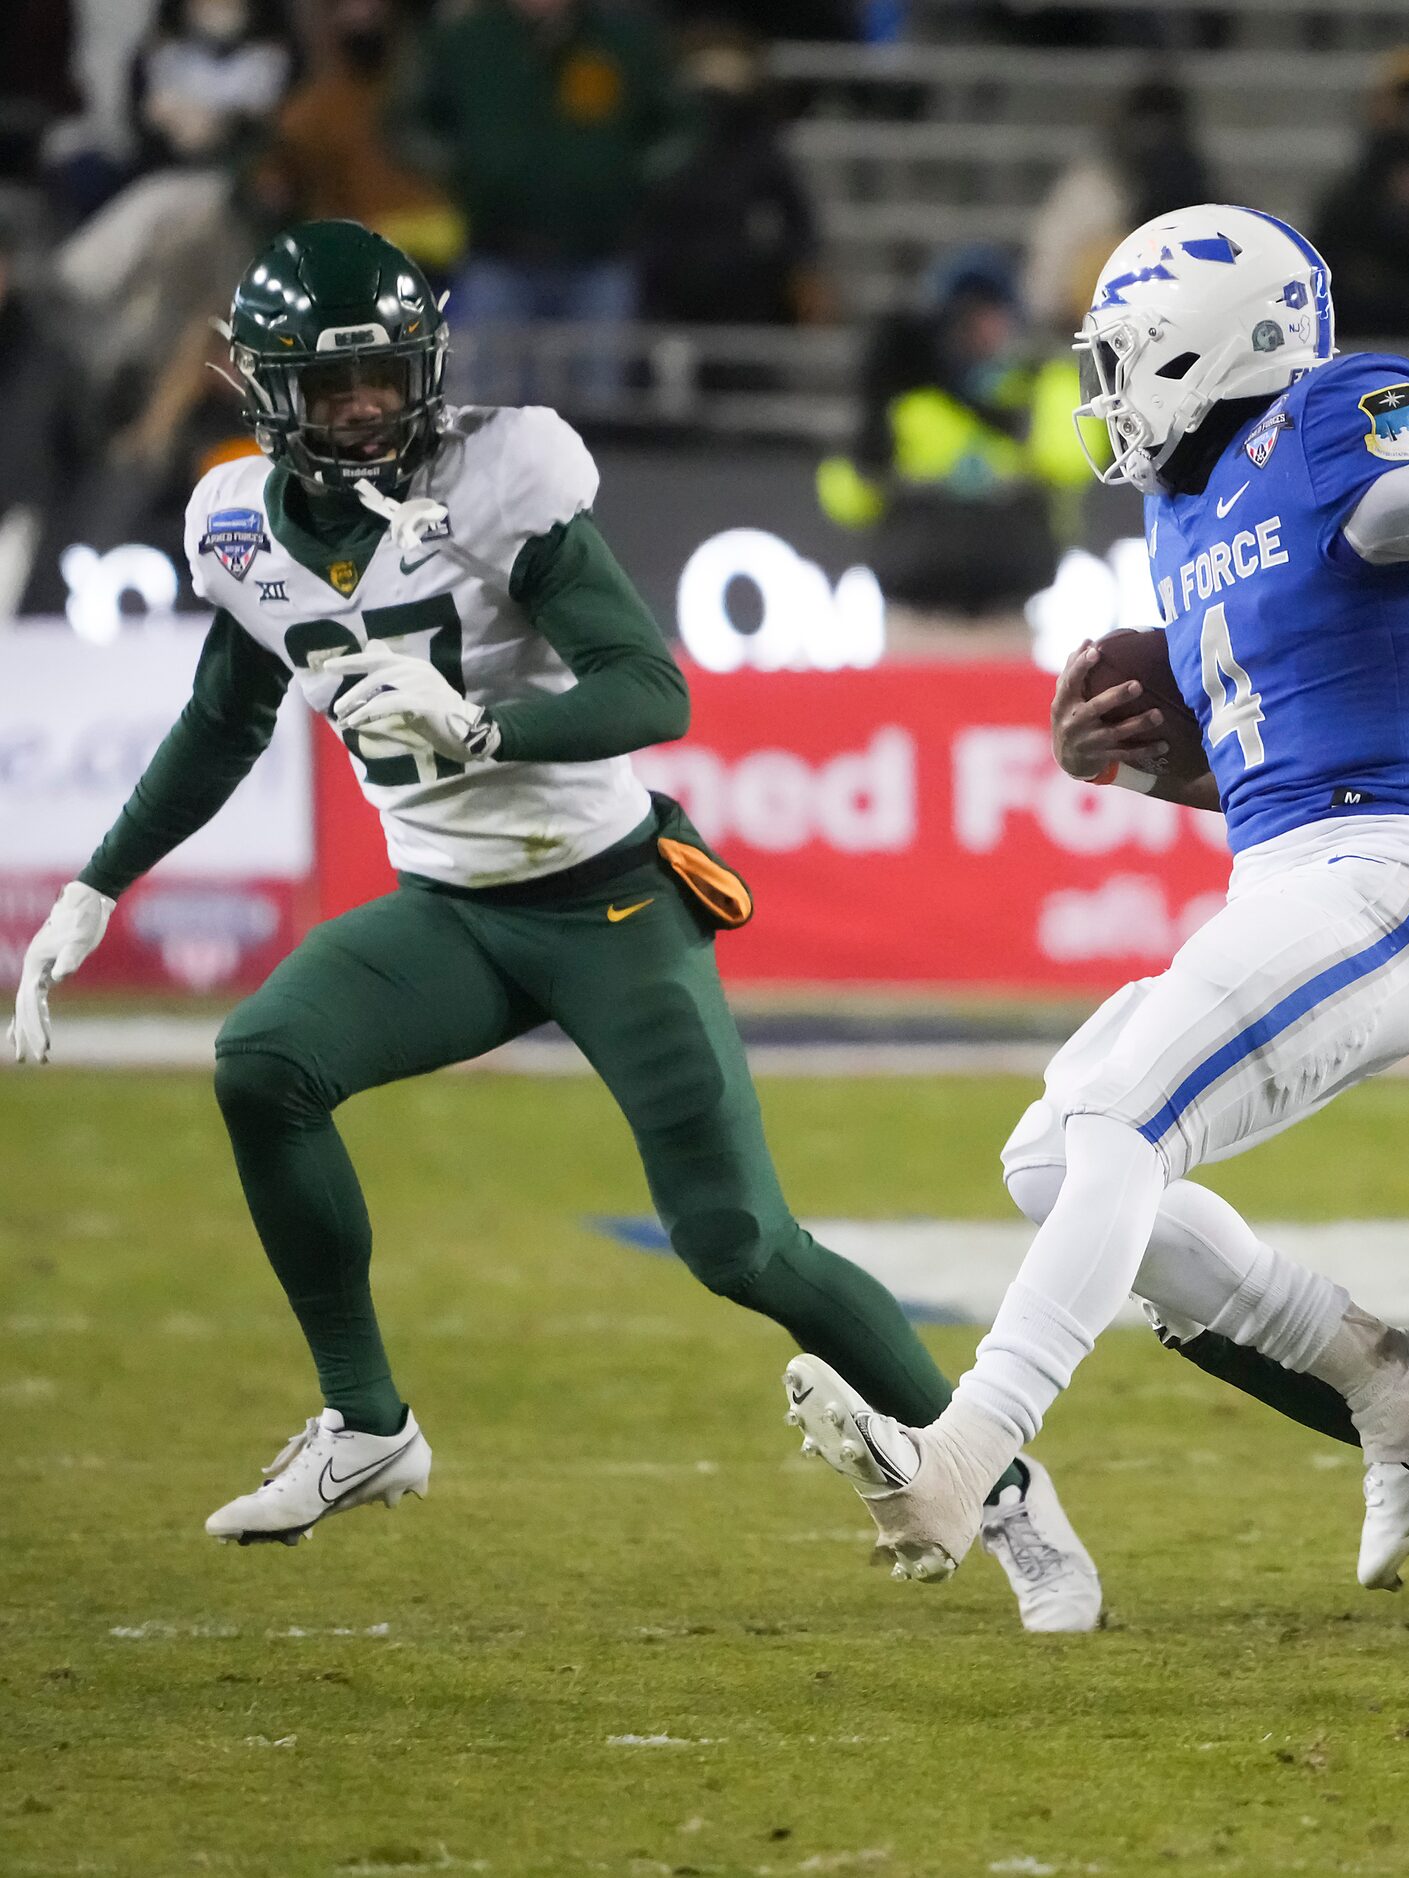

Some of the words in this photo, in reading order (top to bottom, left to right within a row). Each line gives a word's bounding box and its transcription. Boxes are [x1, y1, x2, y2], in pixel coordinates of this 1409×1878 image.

[1289, 324, 1301, 333] NJ
[255, 580, 290, 601] XII
[1180, 515, 1290, 612] FORCE
[284, 591, 466, 786] 27
[1200, 601, 1266, 770] 4
[1344, 791, 1361, 804] M
